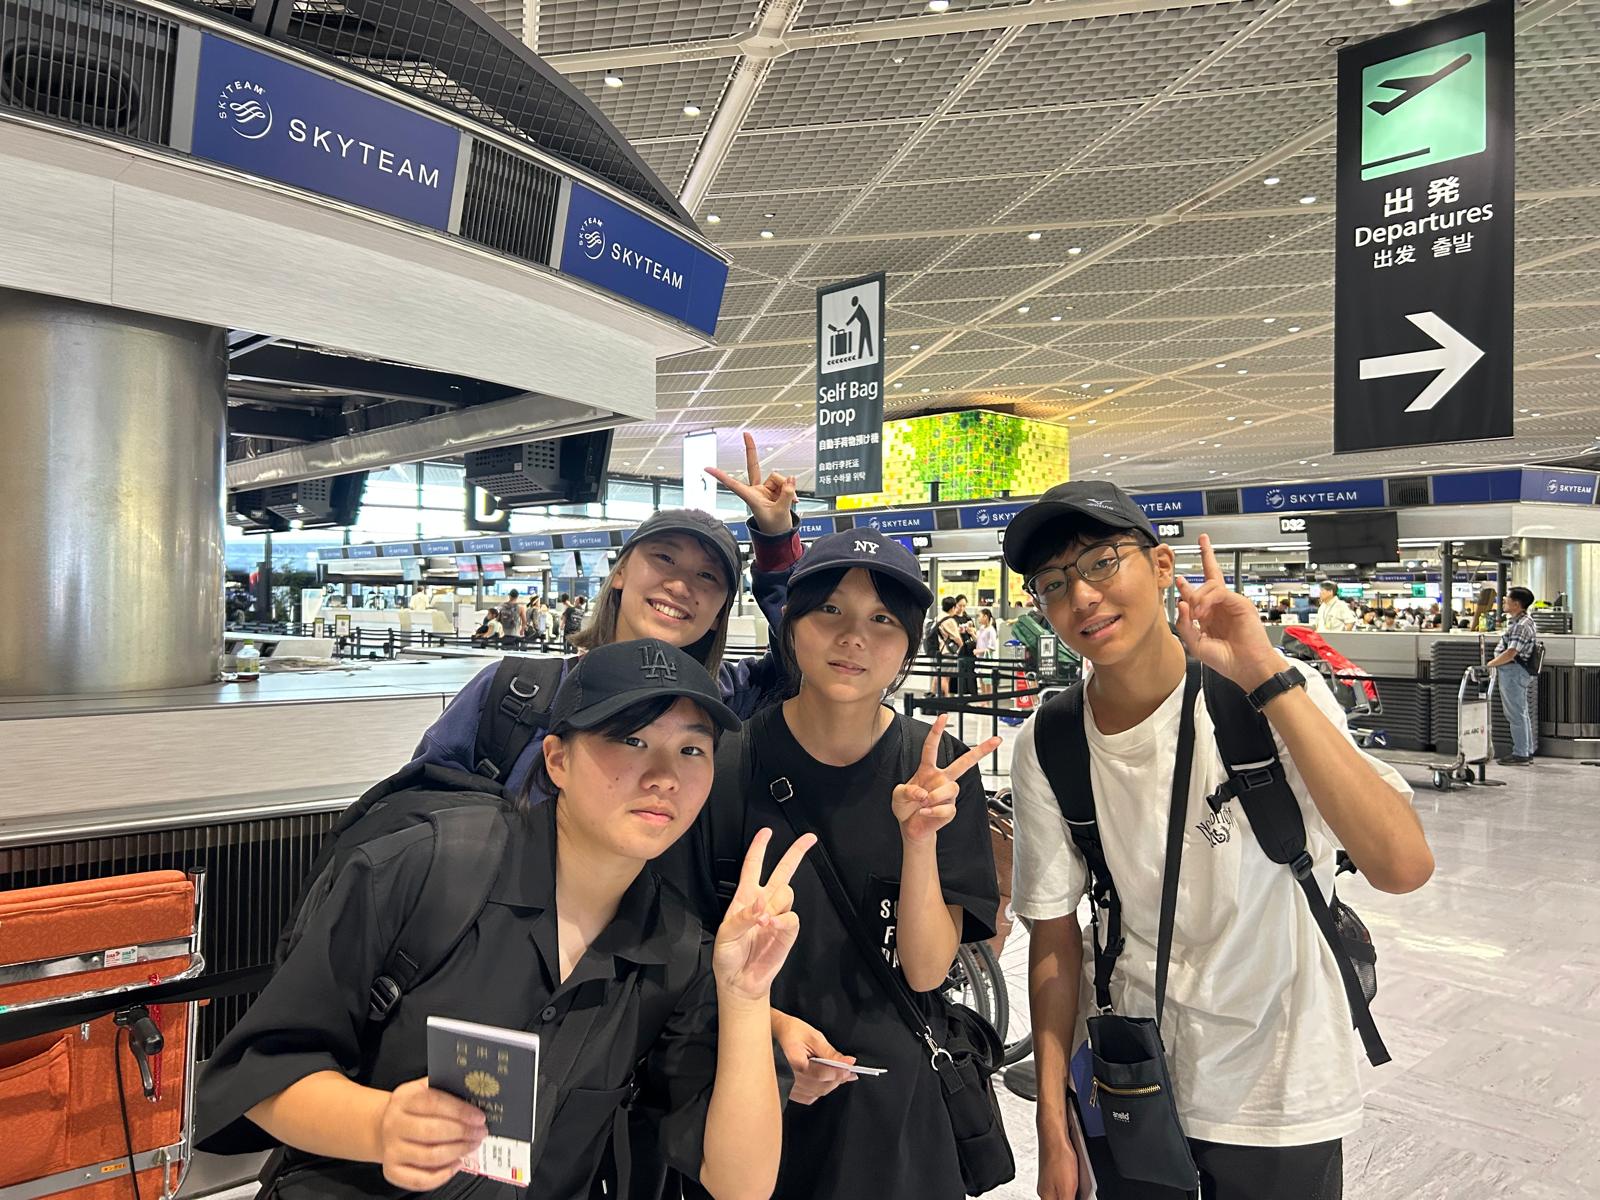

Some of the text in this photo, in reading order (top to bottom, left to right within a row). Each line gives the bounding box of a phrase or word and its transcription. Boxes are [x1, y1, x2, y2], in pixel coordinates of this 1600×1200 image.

[218, 80, 264, 119] SKYTEAM
[288, 118, 440, 189] SKYTEAM
[1384, 175, 1461, 218] 出発
[1354, 203, 1494, 247] Departures
[1431, 231, 1475, 258] 출발
[611, 242, 683, 290] SKYTEAM
[1373, 244, 1417, 269] 出发
[819, 381, 878, 404] Self Bag
[819, 408, 856, 427] Drop
[1290, 491, 1357, 504] SKYTEAM
[1559, 484, 1592, 494] SKYTEAM
[992, 511, 1018, 522] SKYT
[1137, 502, 1182, 513] YTEAM
[799, 524, 822, 532] YTEAM
[881, 518, 920, 528] SKYTEAM
[1281, 518, 1306, 532] D32
[853, 540, 880, 554] NY
[638, 645, 677, 681] LA
[880, 898, 898, 919] S
